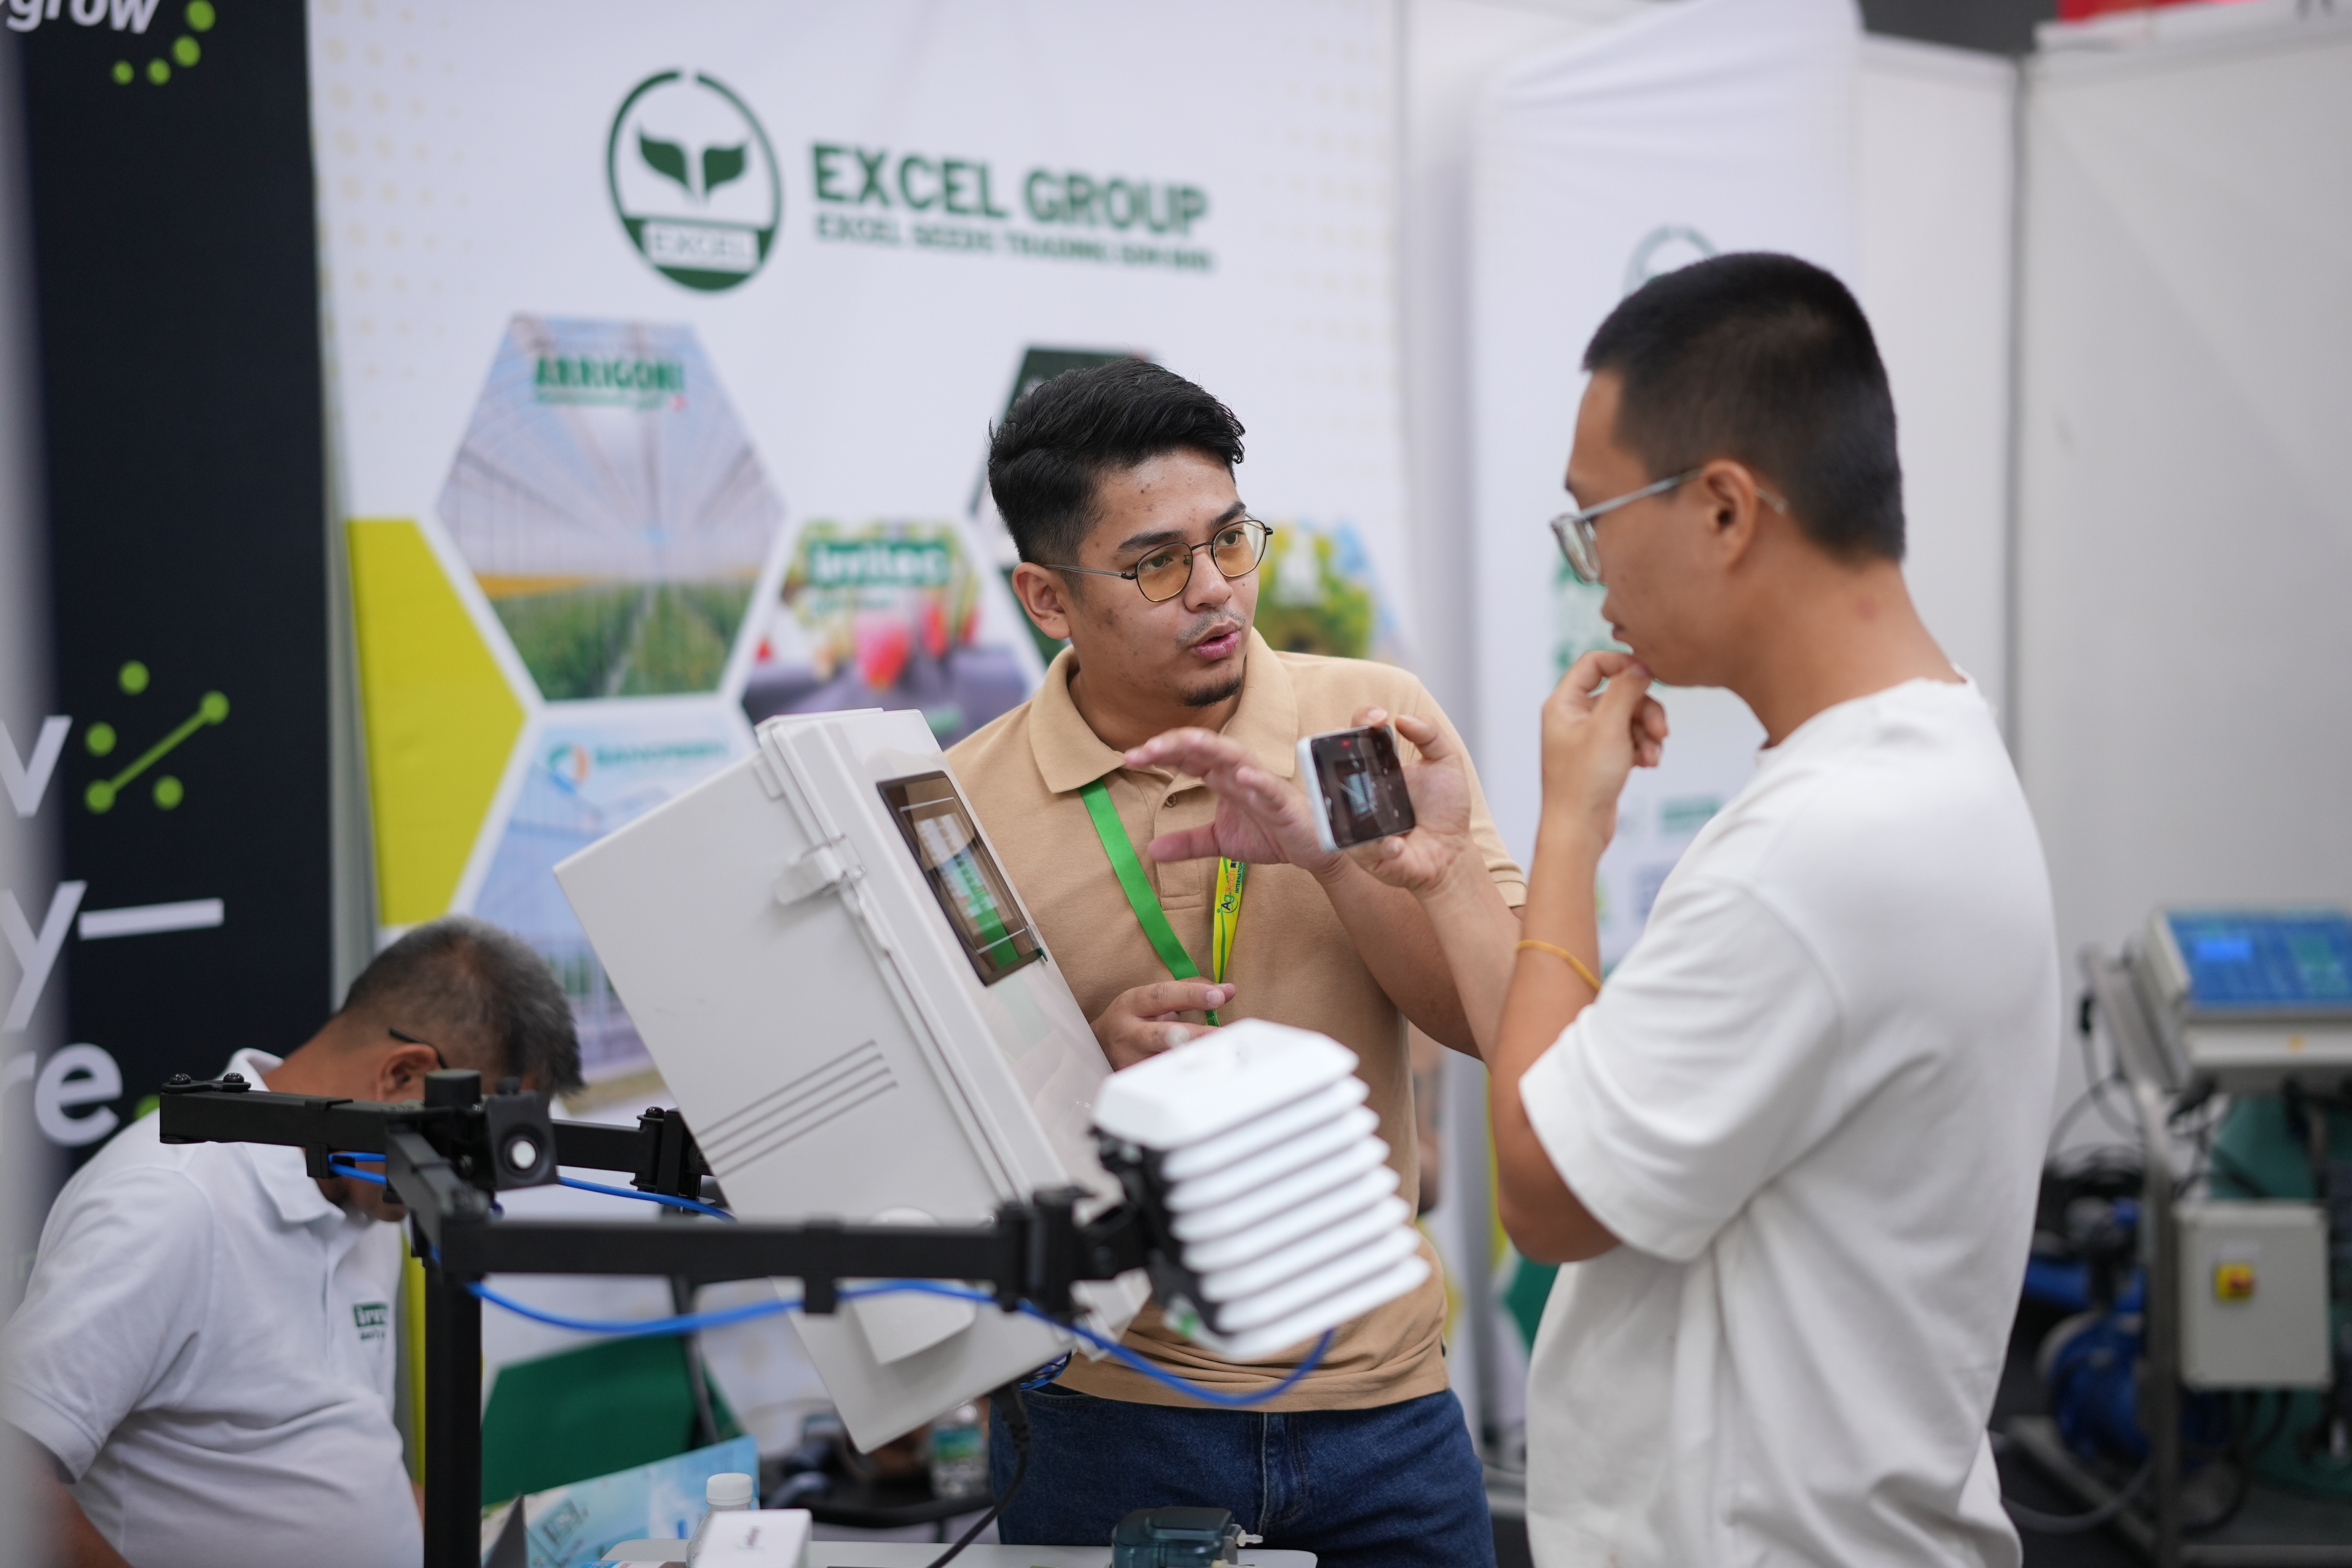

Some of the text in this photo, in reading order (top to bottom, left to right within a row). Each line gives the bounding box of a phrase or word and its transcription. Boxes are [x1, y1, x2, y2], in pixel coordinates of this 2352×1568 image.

[813, 141, 1210, 236] EXCEL GROUP
[651, 230, 750, 260] EXCEL
